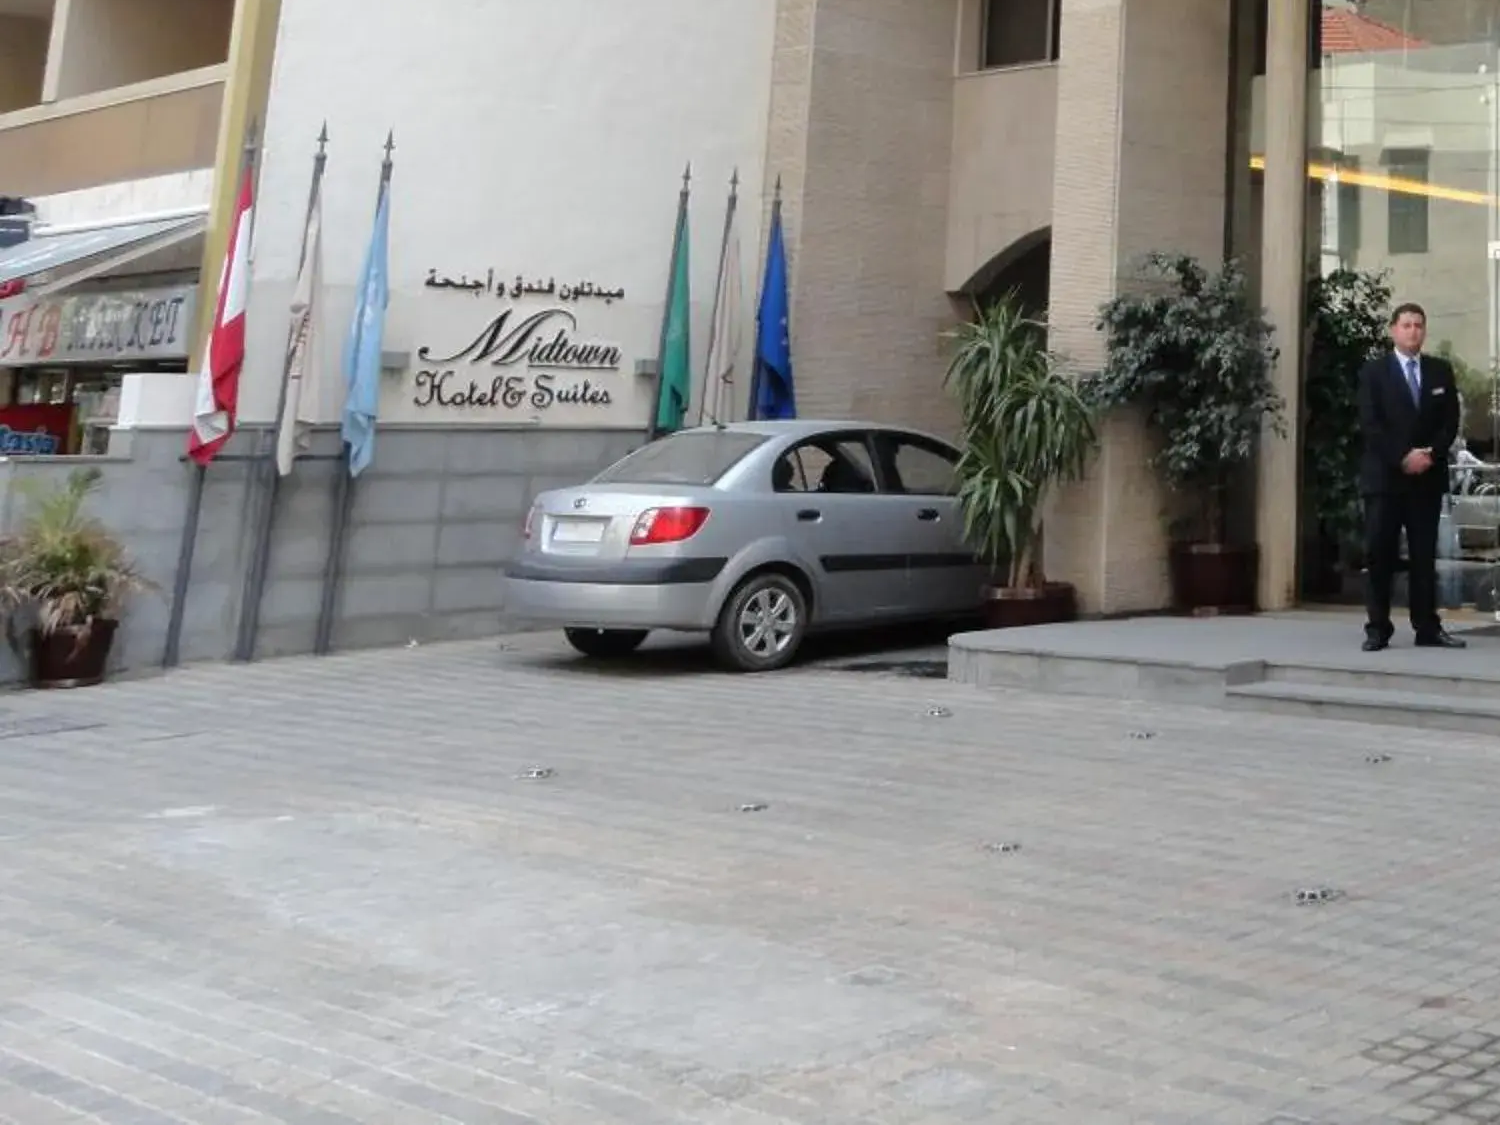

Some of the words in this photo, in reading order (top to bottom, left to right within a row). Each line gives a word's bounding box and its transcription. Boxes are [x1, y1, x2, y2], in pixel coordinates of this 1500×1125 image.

[418, 308, 622, 370] Midtown
[413, 370, 504, 407] Hotel
[531, 374, 612, 409] Suites
